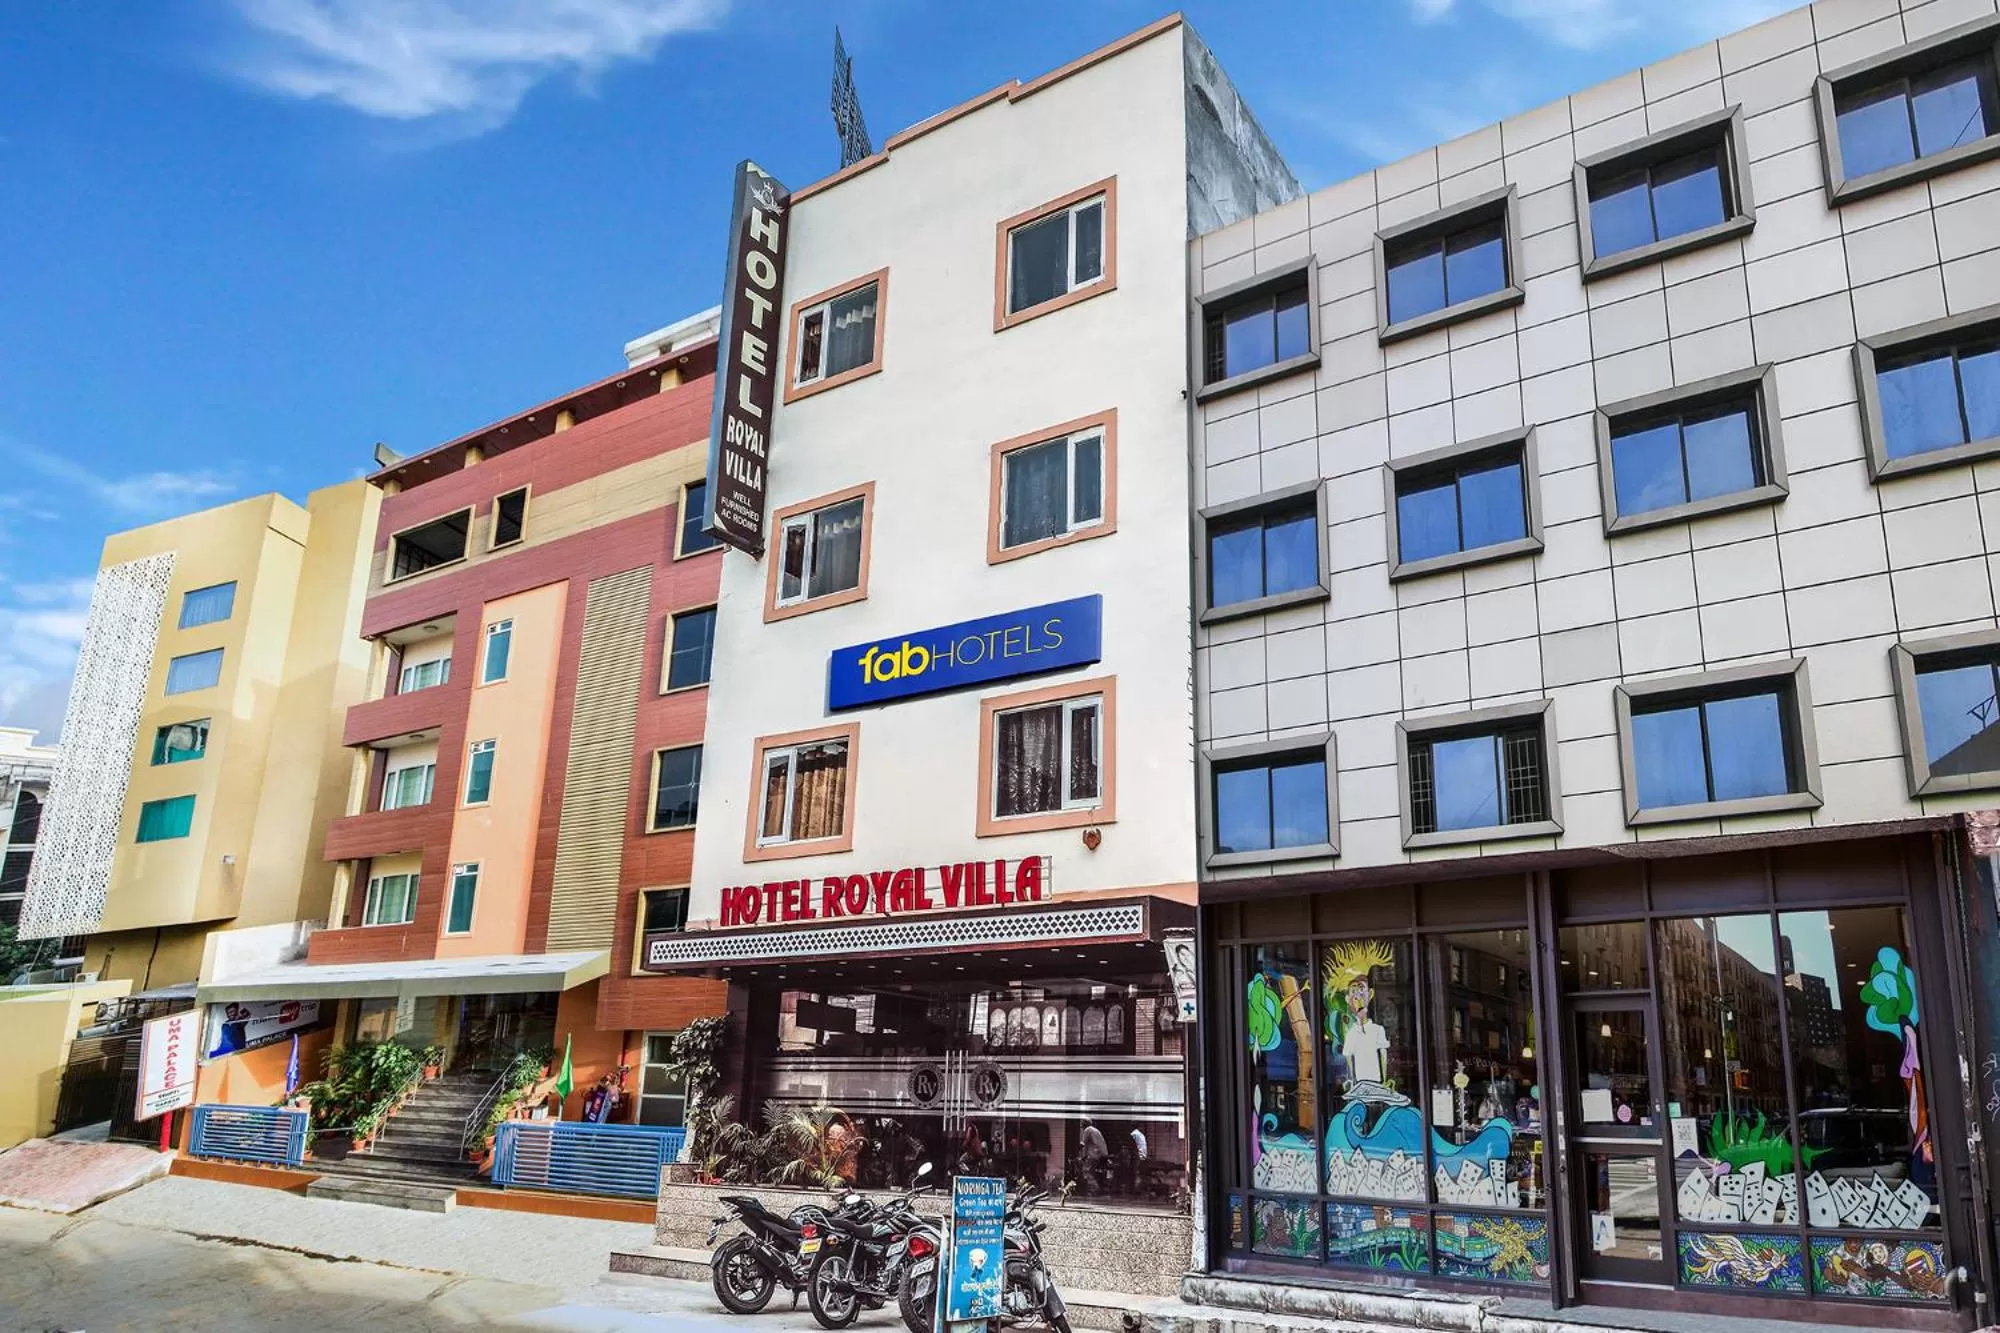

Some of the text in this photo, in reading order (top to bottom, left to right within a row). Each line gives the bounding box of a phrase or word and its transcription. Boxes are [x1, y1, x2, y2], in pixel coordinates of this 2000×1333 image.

[739, 206, 780, 418] HOTEL
[726, 414, 765, 459] ROYAL
[725, 448, 762, 492] VILLA
[720, 495, 760, 522] FURNISHED
[721, 507, 758, 532] AC ROOMS
[732, 489, 752, 508] WELL
[720, 855, 1042, 927] HOTEL ROYAL VILLA
[168, 1018, 182, 1042] UMA
[163, 1044, 179, 1089] PALACE
